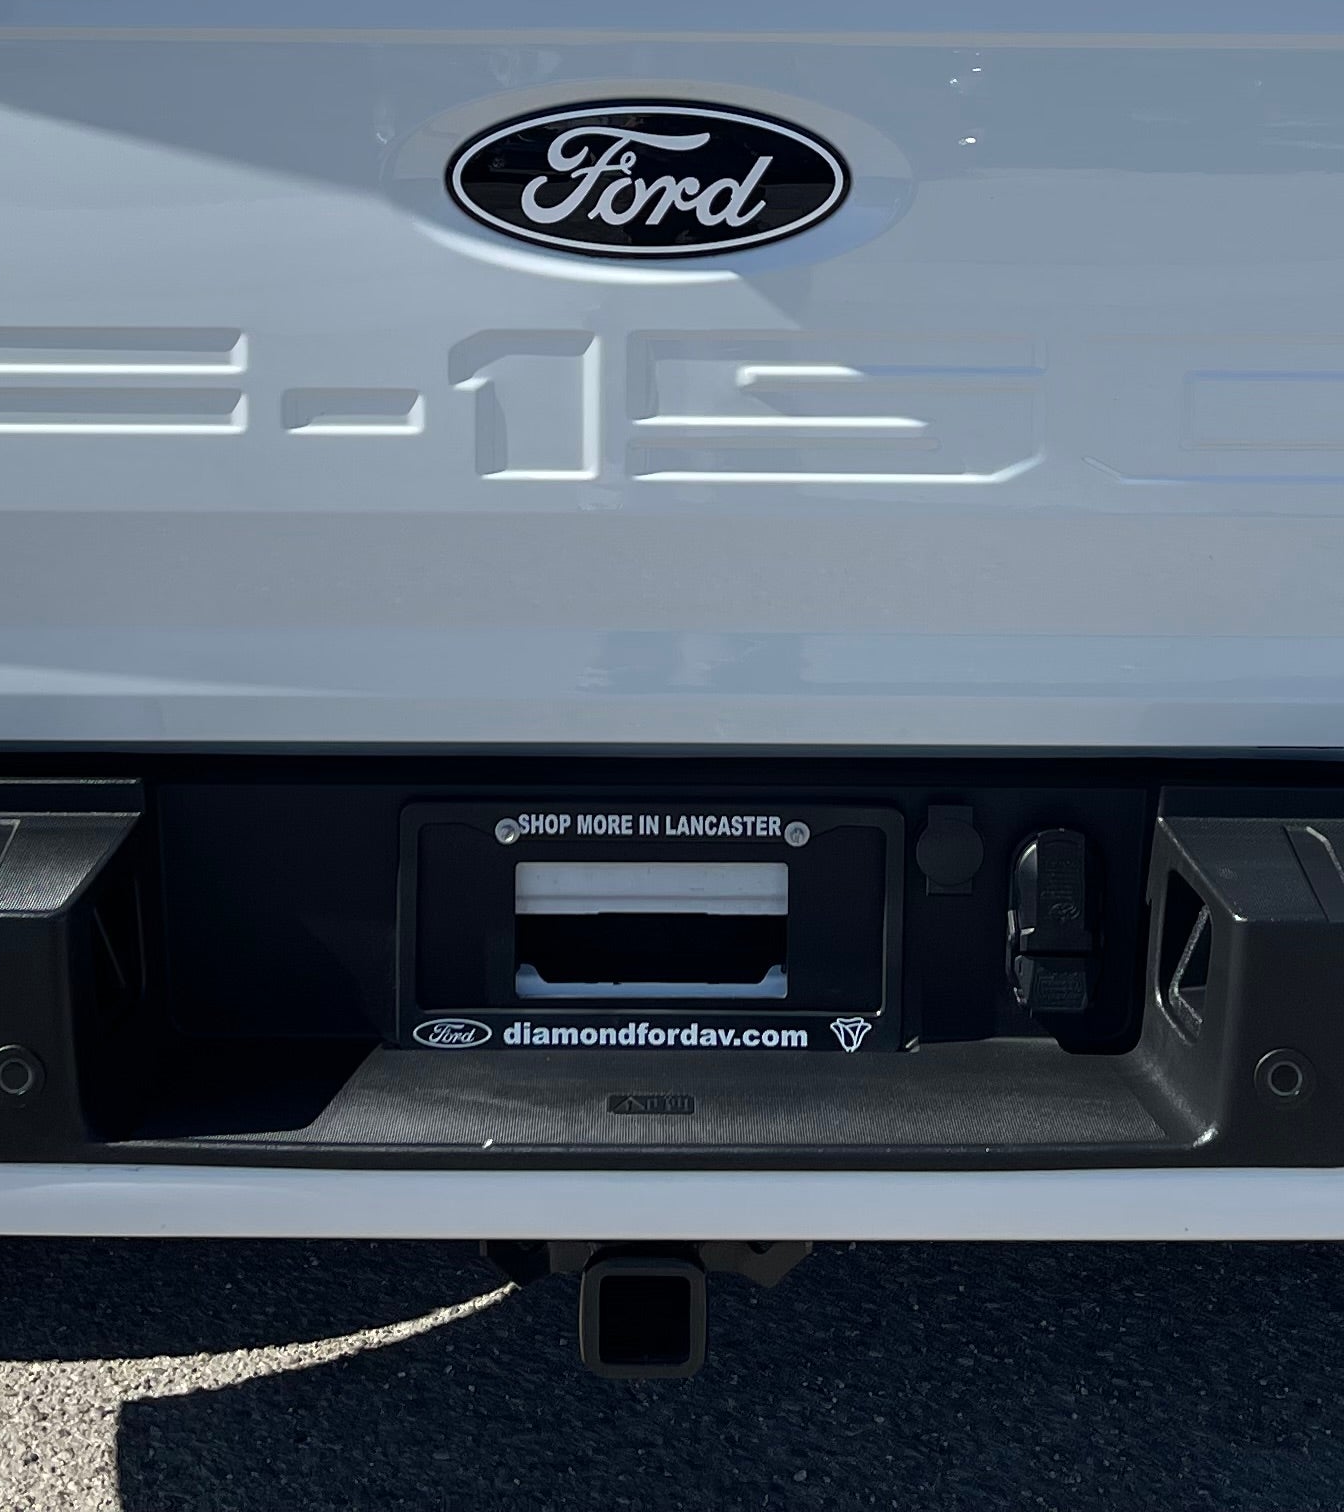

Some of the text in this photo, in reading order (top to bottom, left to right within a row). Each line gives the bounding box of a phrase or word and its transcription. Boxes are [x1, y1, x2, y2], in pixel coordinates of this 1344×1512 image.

[521, 126, 774, 227] Ford
[518, 813, 782, 837] SHOP MORE IN LANCASTER
[429, 1024, 476, 1043] Ford
[503, 1022, 808, 1048] diamondfordav.com
